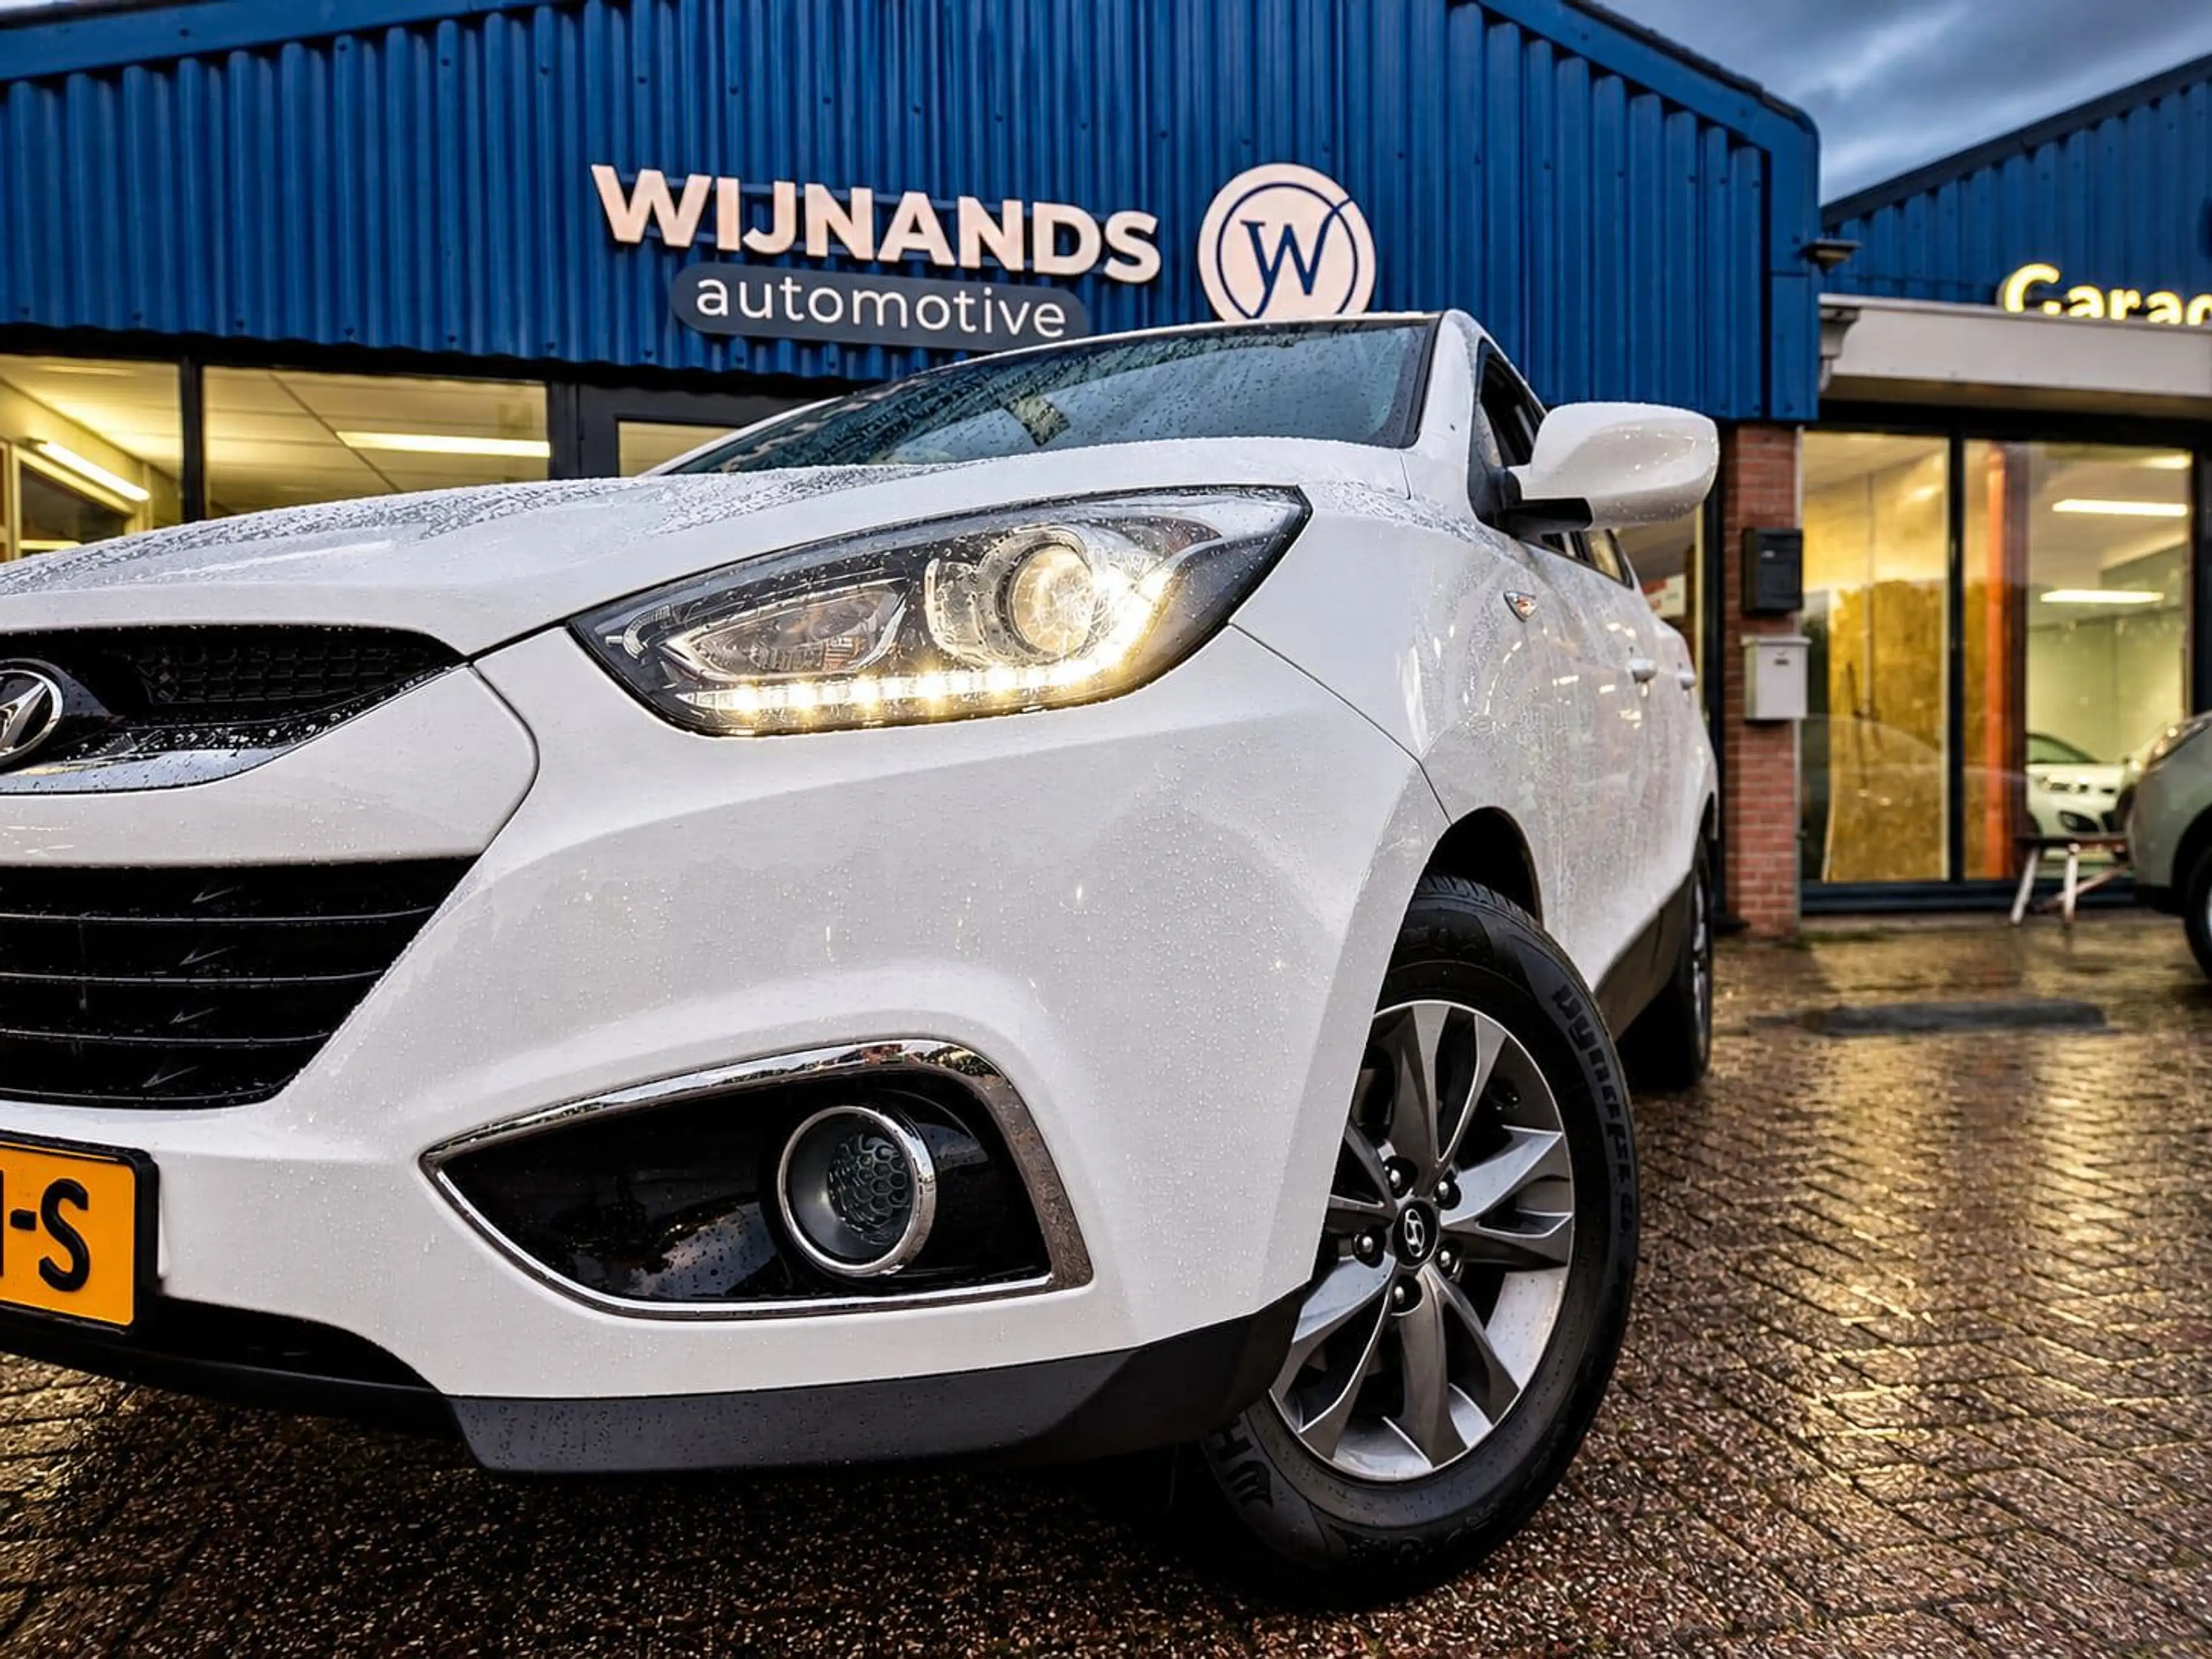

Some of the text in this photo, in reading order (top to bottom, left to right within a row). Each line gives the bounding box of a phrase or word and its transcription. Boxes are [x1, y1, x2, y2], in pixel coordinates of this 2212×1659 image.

[591, 164, 1161, 283] WIJNANDS
[696, 275, 1066, 338] automotive
[0, 1169, 91, 1292] -S
